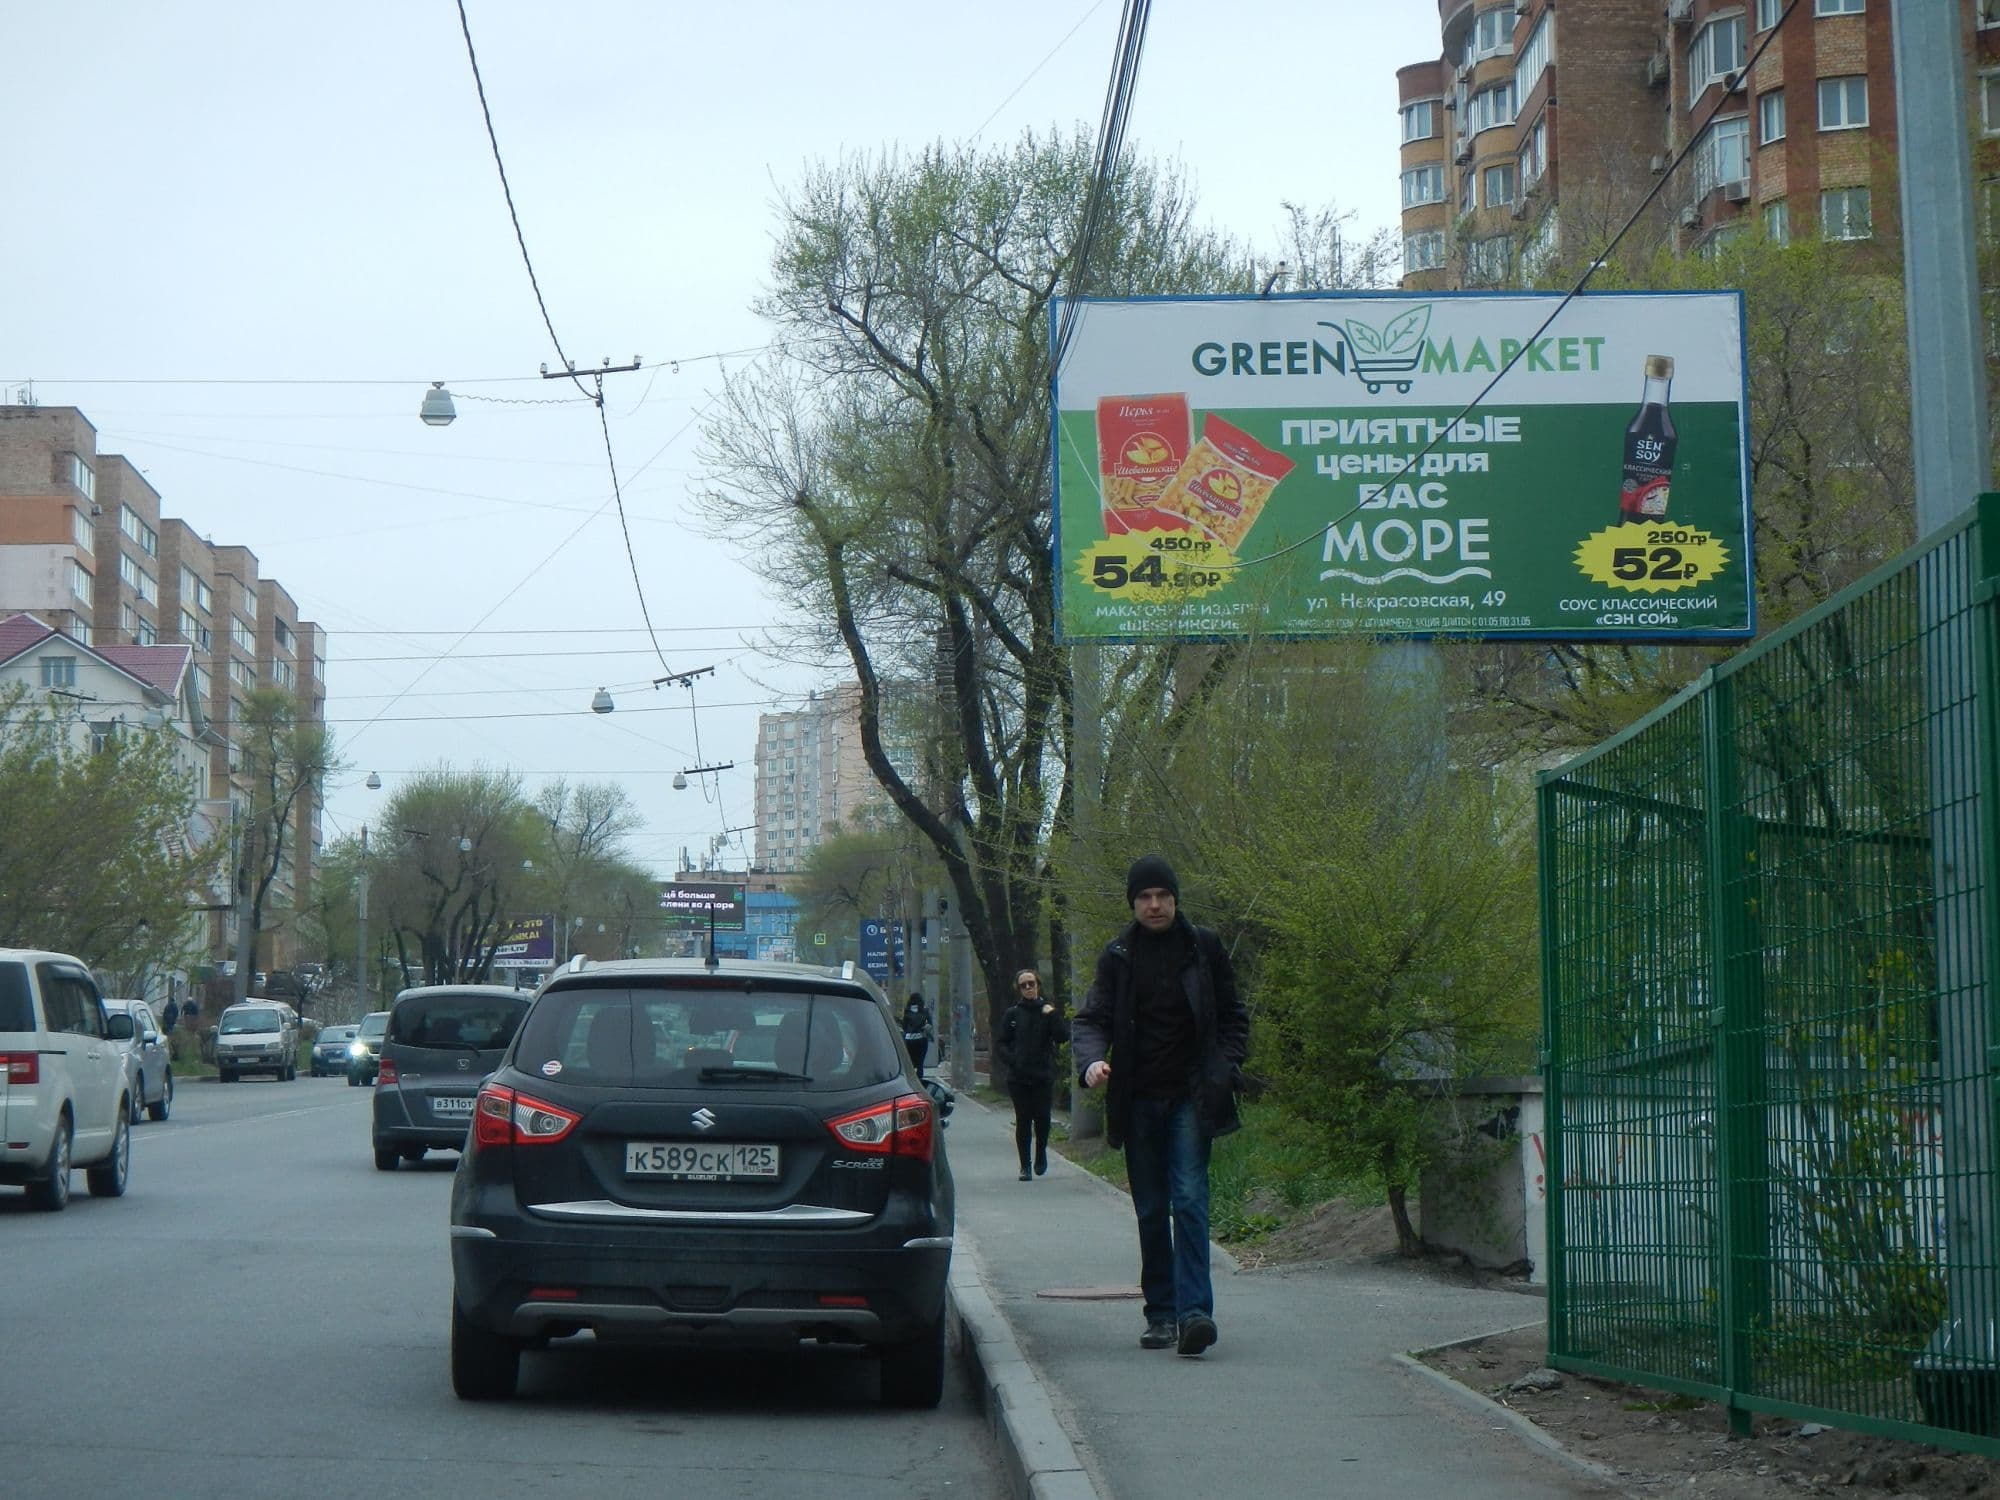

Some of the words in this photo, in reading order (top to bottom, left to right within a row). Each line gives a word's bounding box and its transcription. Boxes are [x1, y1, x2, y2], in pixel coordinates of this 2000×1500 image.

[1191, 338, 1347, 377] GREEN
[1281, 415, 1522, 446] ПРИЯТНЫЕ
[1636, 440, 1662, 451] SEN
[1635, 450, 1661, 463] SOY
[1316, 453, 1416, 481] цены
[1420, 452, 1489, 477] для
[1359, 482, 1449, 509] ВАС
[1150, 537, 1193, 550] 450
[1194, 541, 1212, 552] гр
[1322, 518, 1490, 562] МОРЕ
[1647, 530, 1688, 544] 250
[1690, 535, 1708, 546] гр
[1340, 592, 1476, 613] Некрасовская,
[1481, 590, 1507, 606] 49
[1559, 599, 1598, 611] СОУС
[1602, 595, 1718, 610] КЛАССИЧЕСКИЙ
[1595, 613, 1634, 625] «СЭН
[1638, 610, 1678, 625] СОЙ»
[677, 890, 716, 899] больше
[704, 902, 735, 911] доре
[634, 1147, 730, 1172] К589СК
[736, 1147, 772, 1166] 125
[743, 1165, 761, 1174] RUS
